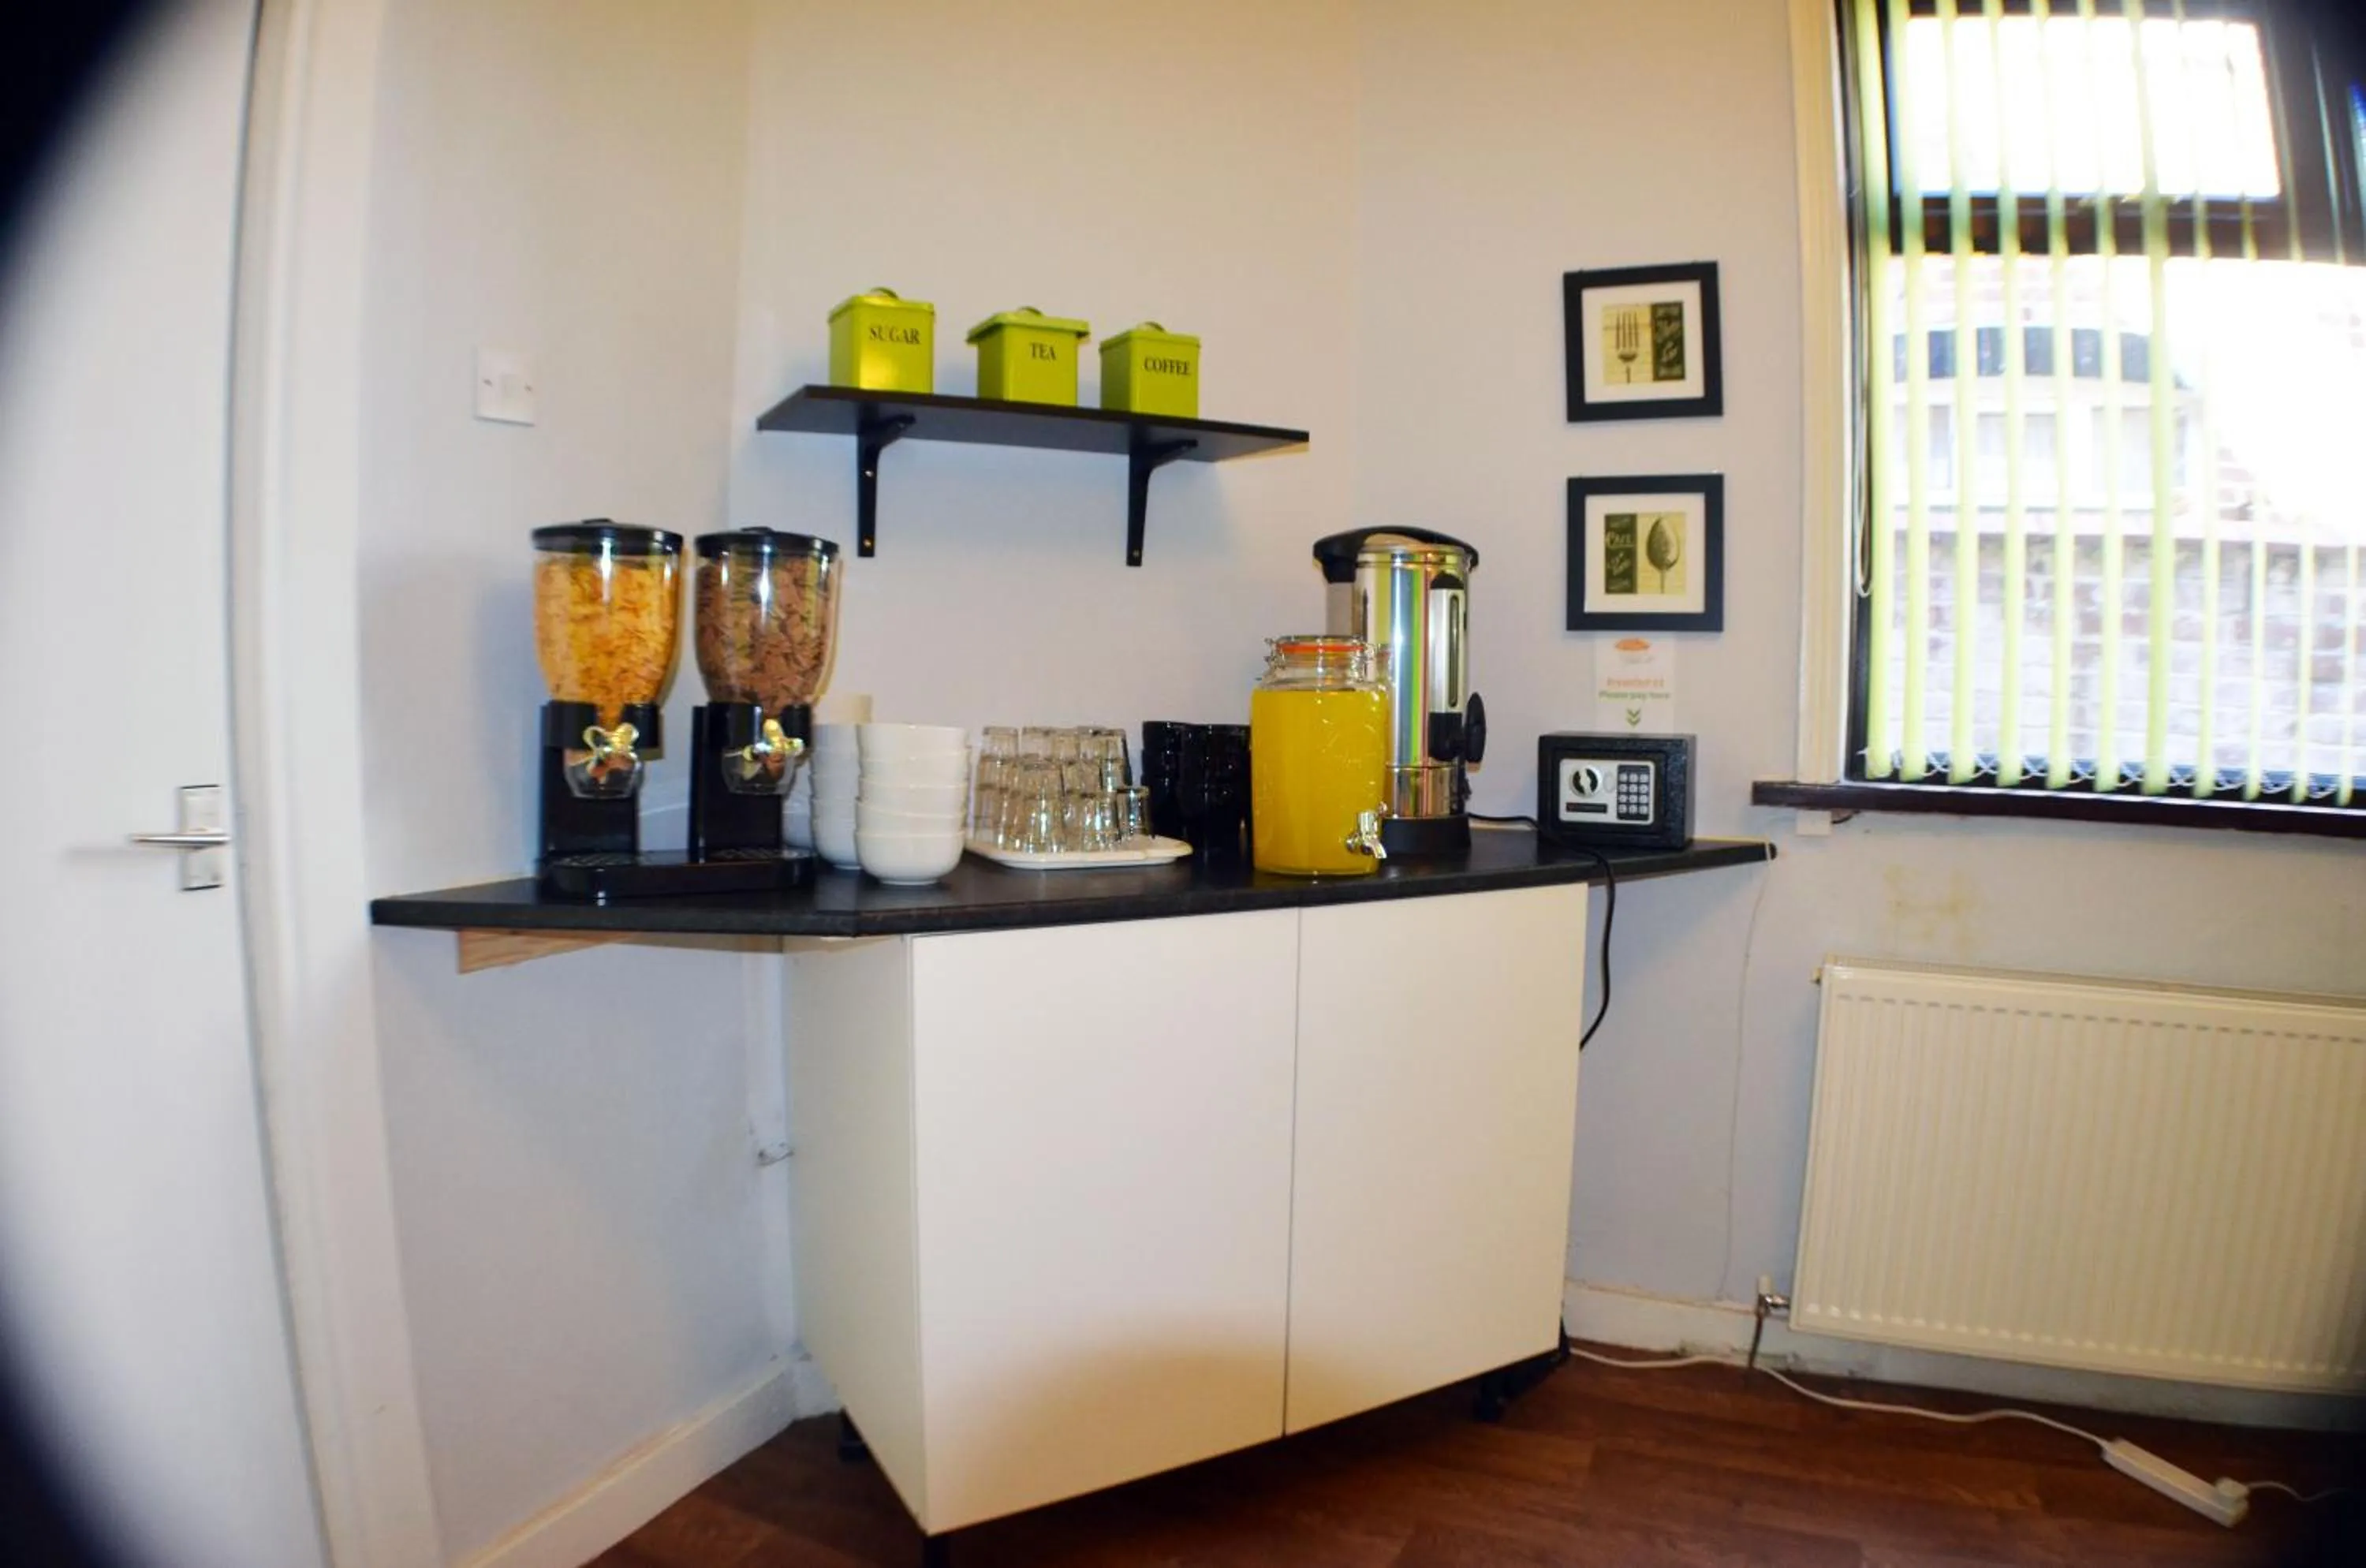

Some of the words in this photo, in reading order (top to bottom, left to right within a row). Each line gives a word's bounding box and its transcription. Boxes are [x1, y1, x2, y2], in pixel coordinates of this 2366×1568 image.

[869, 326, 921, 345] SUGAR
[1029, 342, 1057, 361] TEA
[1144, 356, 1191, 376] COFFEE
